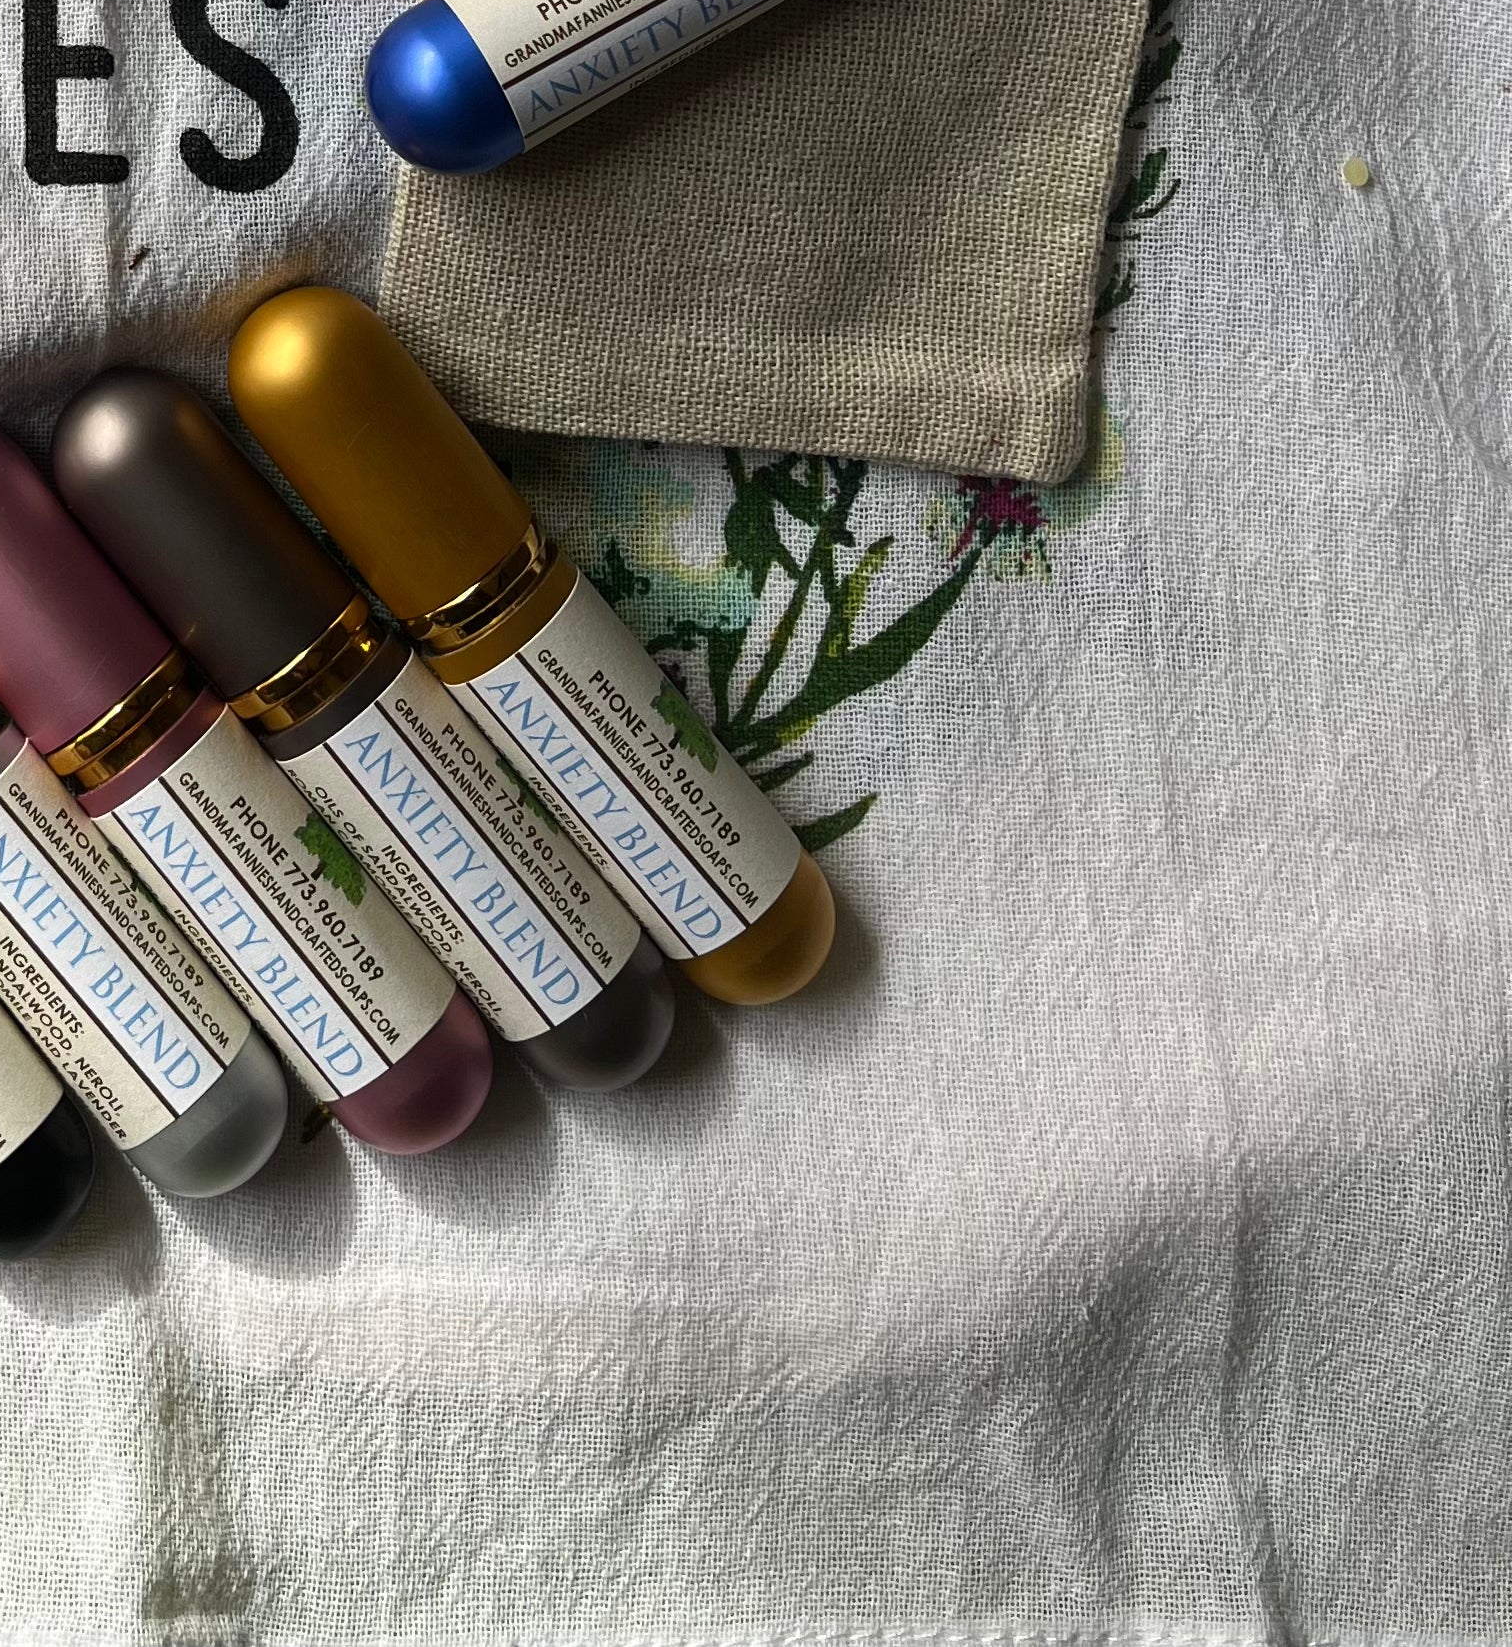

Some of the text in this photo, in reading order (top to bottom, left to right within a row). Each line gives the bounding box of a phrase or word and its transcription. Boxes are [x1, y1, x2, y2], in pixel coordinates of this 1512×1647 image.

[527, 6, 687, 122] ANXIETY
[315, 786, 345, 820] OILS
[343, 821, 364, 844] OF
[395, 698, 613, 969] GRANDMAFANNIESHANDCRAFTEDSOAPS.COM
[441, 723, 497, 792] PHONE
[493, 790, 591, 905] 773.960.7189
[487, 679, 629, 823] ANXIETY
[615, 823, 722, 940] BLEND
[538, 649, 759, 908] GRANDMAFANNIESHANDCRAFTEDSOAPS.COM
[589, 670, 742, 847] PHONE 773.960.7189
[8, 783, 229, 1050] GRANDMAFANNIESHANDCRAFTEDSOAPS.COM
[56, 808, 205, 987] PHONE 773.960.7189
[129, 805, 270, 951] ANXIETY
[256, 954, 363, 1078] BLEND
[179, 773, 400, 1047] GRANDMAFANNIESHANDCRAFTEDSOAPS.COM
[231, 796, 384, 982] PHONE 773.960.7189
[345, 731, 487, 884] ANXIETY
[473, 879, 580, 1006] BLEND
[0, 936, 85, 1039] INGREDIENTS:
[33, 1025, 62, 1061] AND
[91, 962, 201, 1091] BLEND
[74, 1057, 125, 1117] NEROLI,
